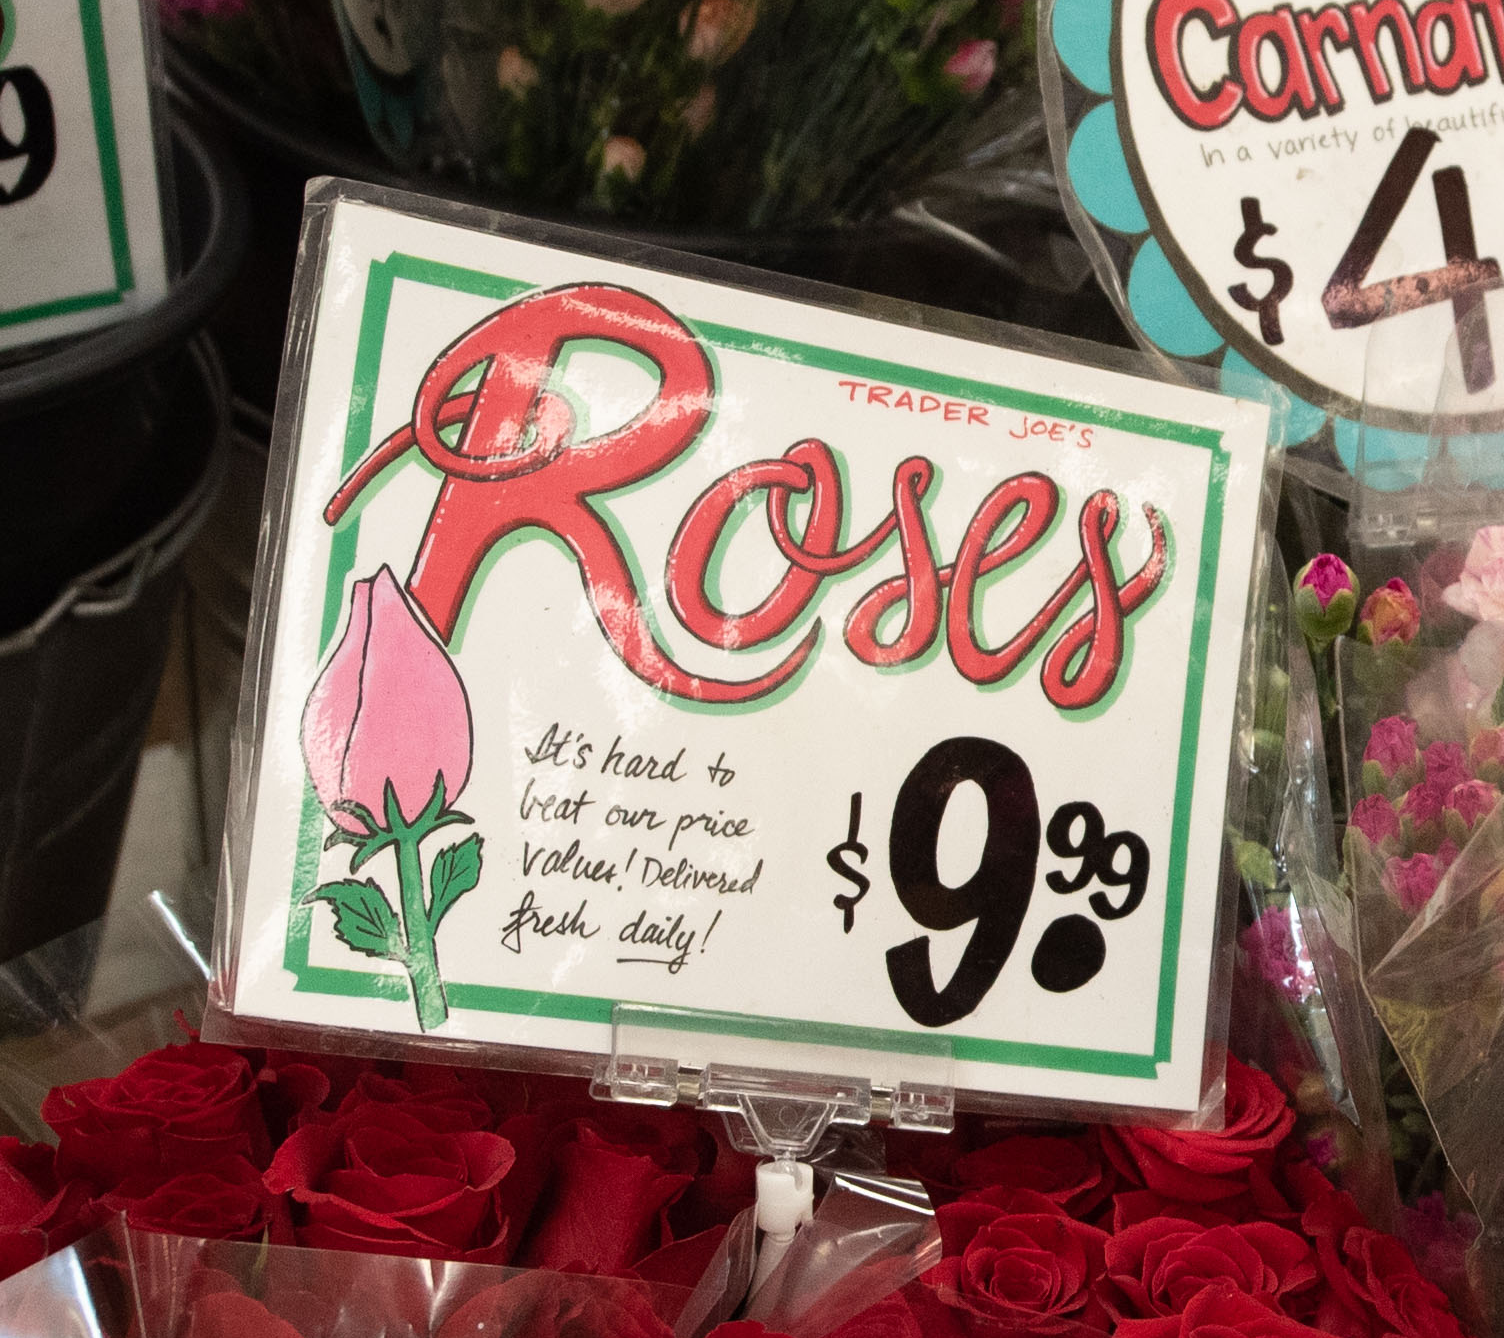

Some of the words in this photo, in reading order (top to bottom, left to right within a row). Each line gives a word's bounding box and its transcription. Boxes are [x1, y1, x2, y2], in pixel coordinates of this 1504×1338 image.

[1235, 142, 1256, 165] a
[1266, 120, 1360, 163] variety
[1372, 115, 1398, 143] of
[838, 378, 991, 429] TRADER
[1009, 413, 1096, 452] JOE'S
[323, 280, 1176, 711] Roses
[523, 719, 594, 770] It's
[600, 736, 690, 789] hard
[707, 746, 739, 790] to
[517, 780, 593, 828] beat
[604, 802, 669, 837] our
[673, 802, 757, 850] price
[520, 835, 634, 897] values!
[640, 853, 766, 901] Delivered
[498, 886, 602, 955] fresh
[615, 907, 721, 975] daily!
